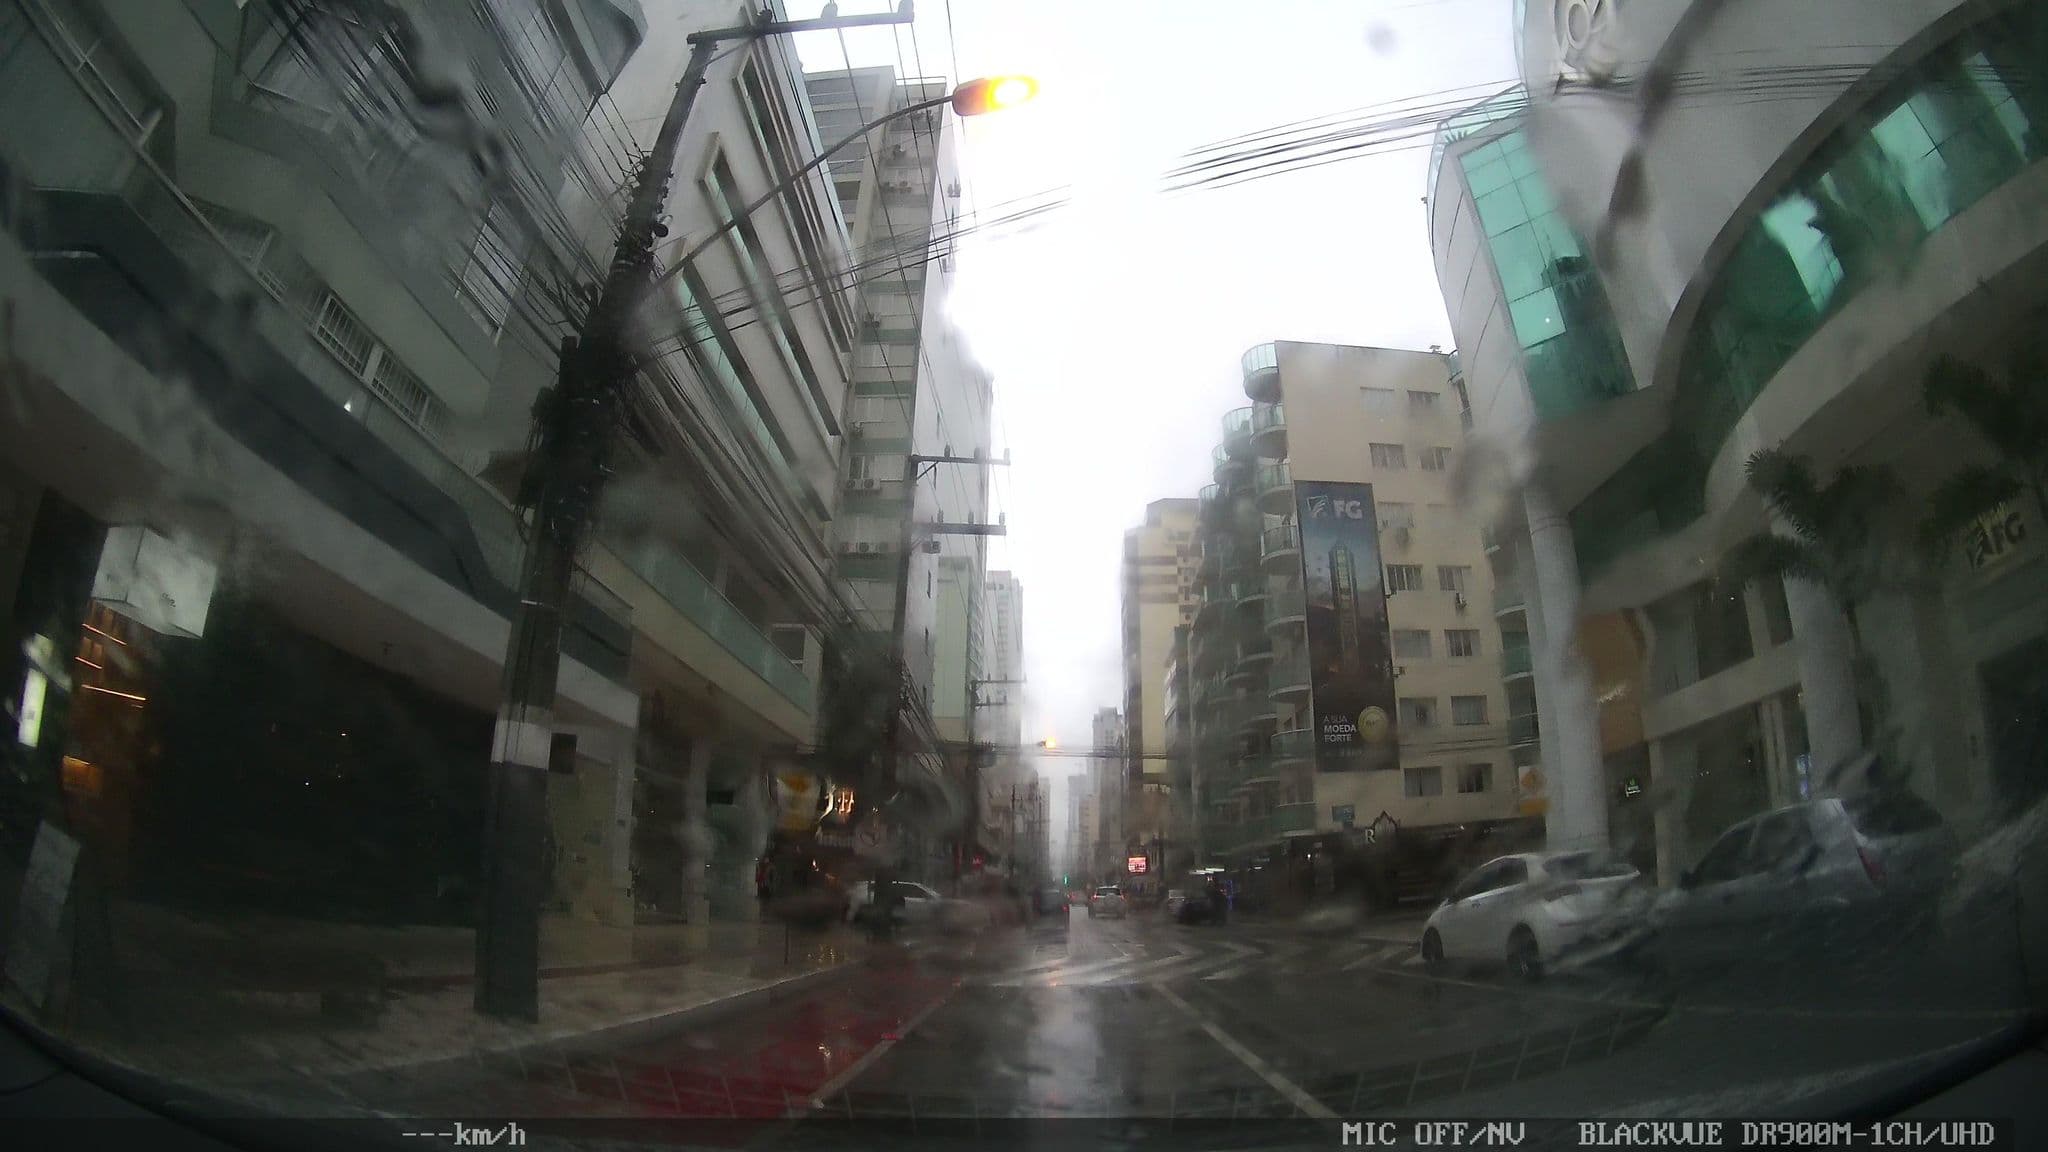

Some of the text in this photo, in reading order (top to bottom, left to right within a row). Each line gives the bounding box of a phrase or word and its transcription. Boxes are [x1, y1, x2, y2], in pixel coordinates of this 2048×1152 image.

[1333, 500, 1363, 519] FG
[1323, 724, 1357, 733] MOEDA
[1323, 734, 1352, 743] FORTE
